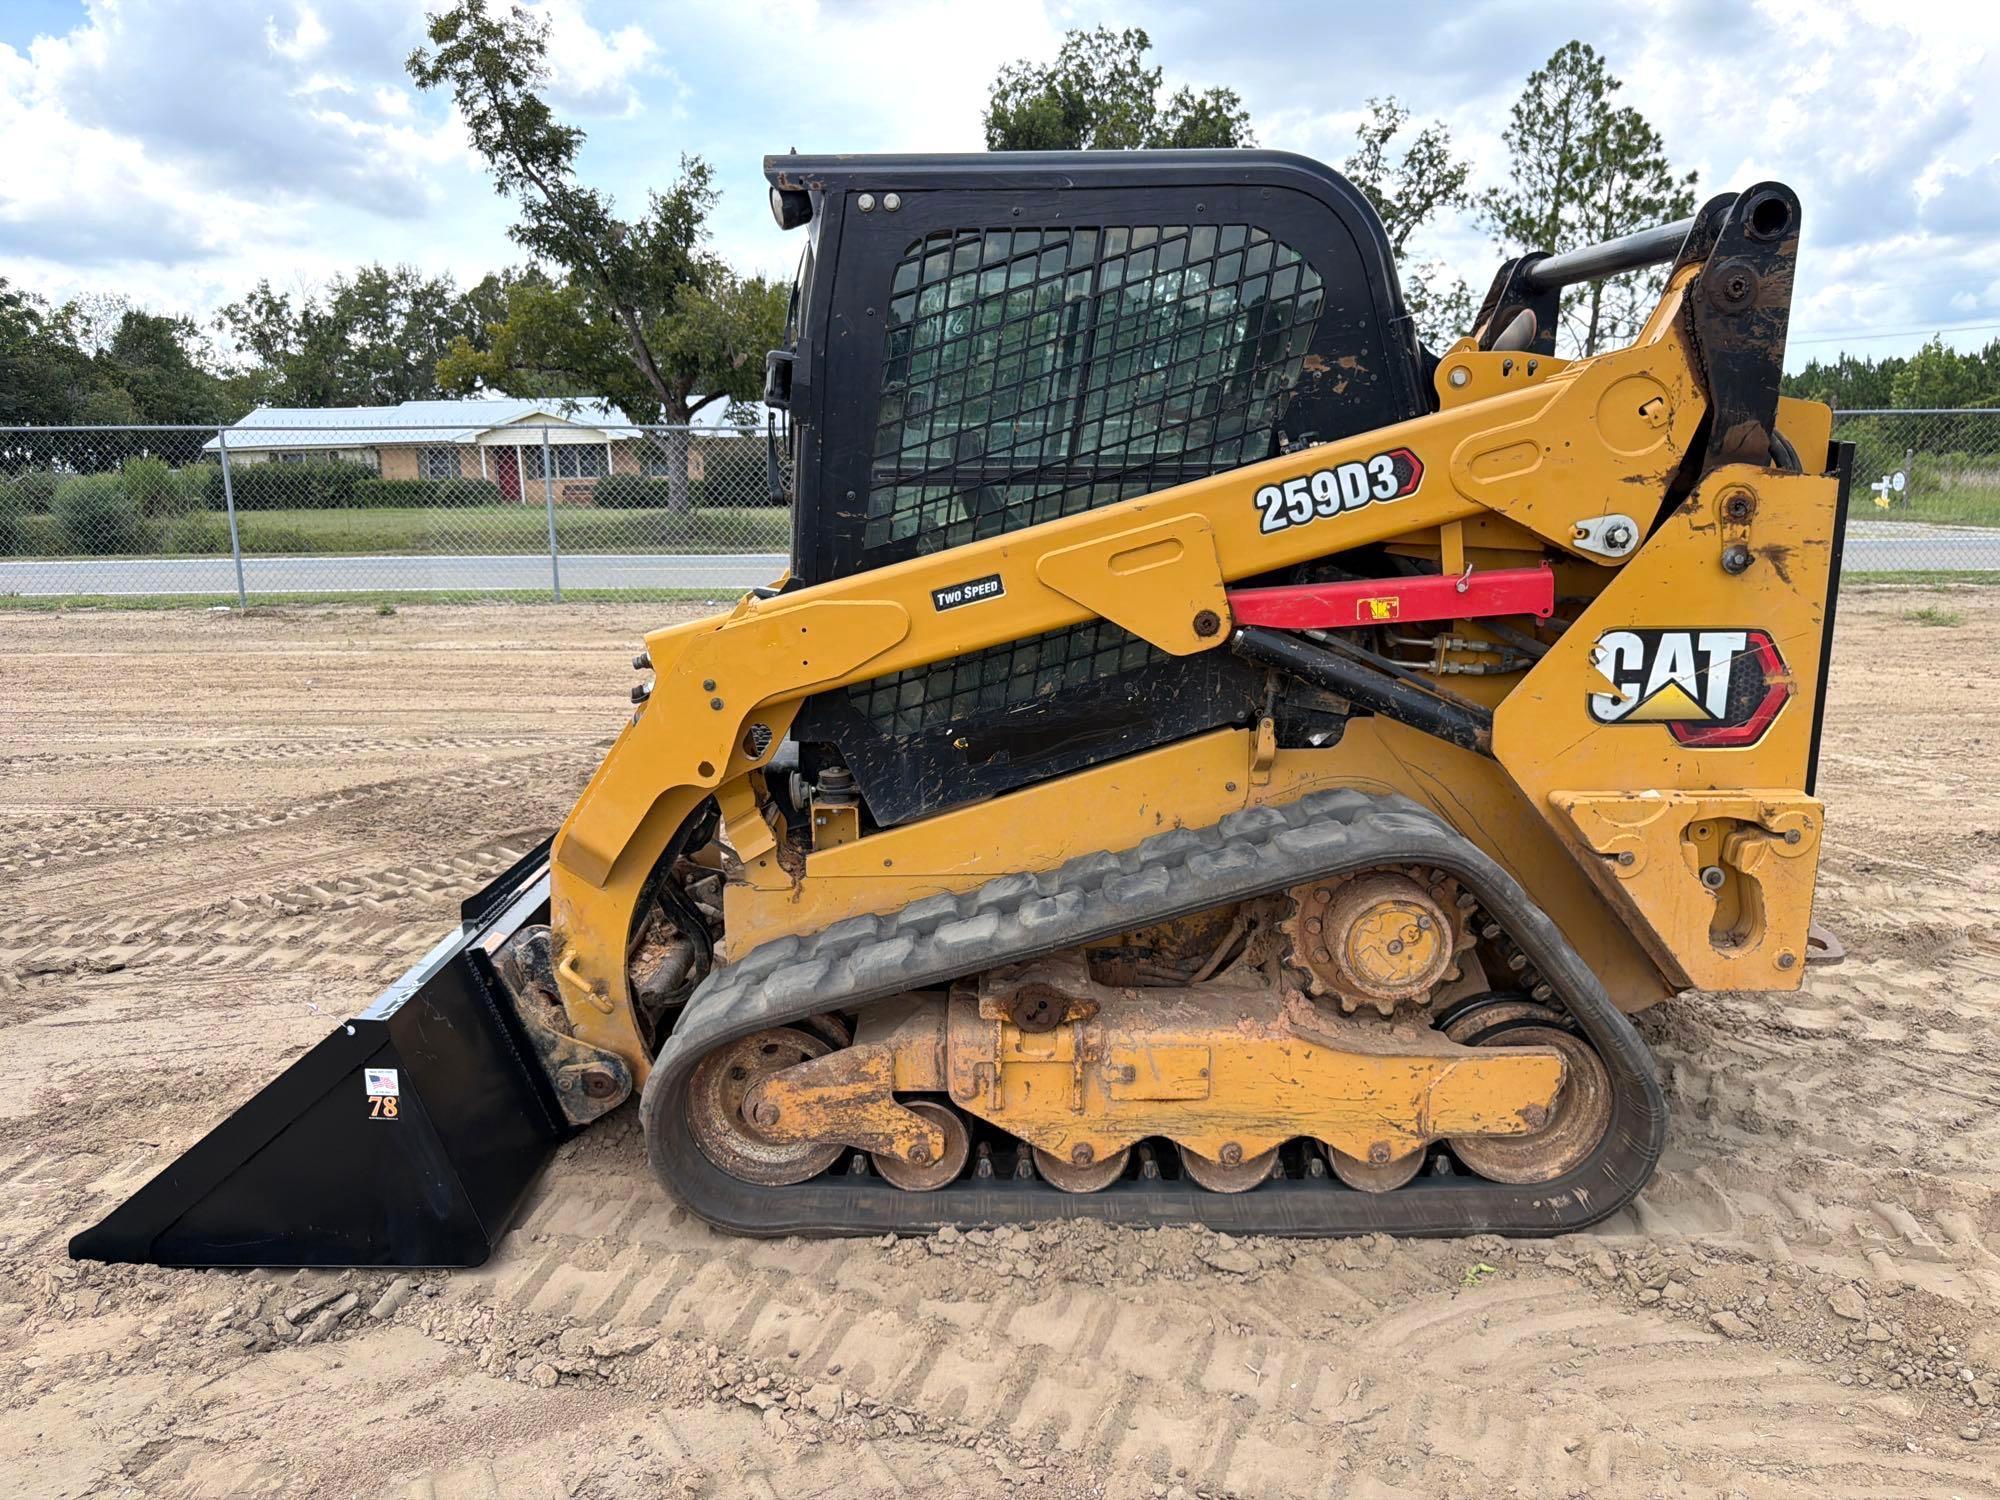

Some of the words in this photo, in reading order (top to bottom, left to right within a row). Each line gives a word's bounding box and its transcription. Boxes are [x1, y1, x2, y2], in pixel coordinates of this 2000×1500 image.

[1256, 455, 1399, 532] 259D3
[937, 591, 961, 606] TWO
[964, 581, 998, 599] SPEED
[1592, 631, 1747, 720] CAT
[368, 1096, 398, 1117] 78
